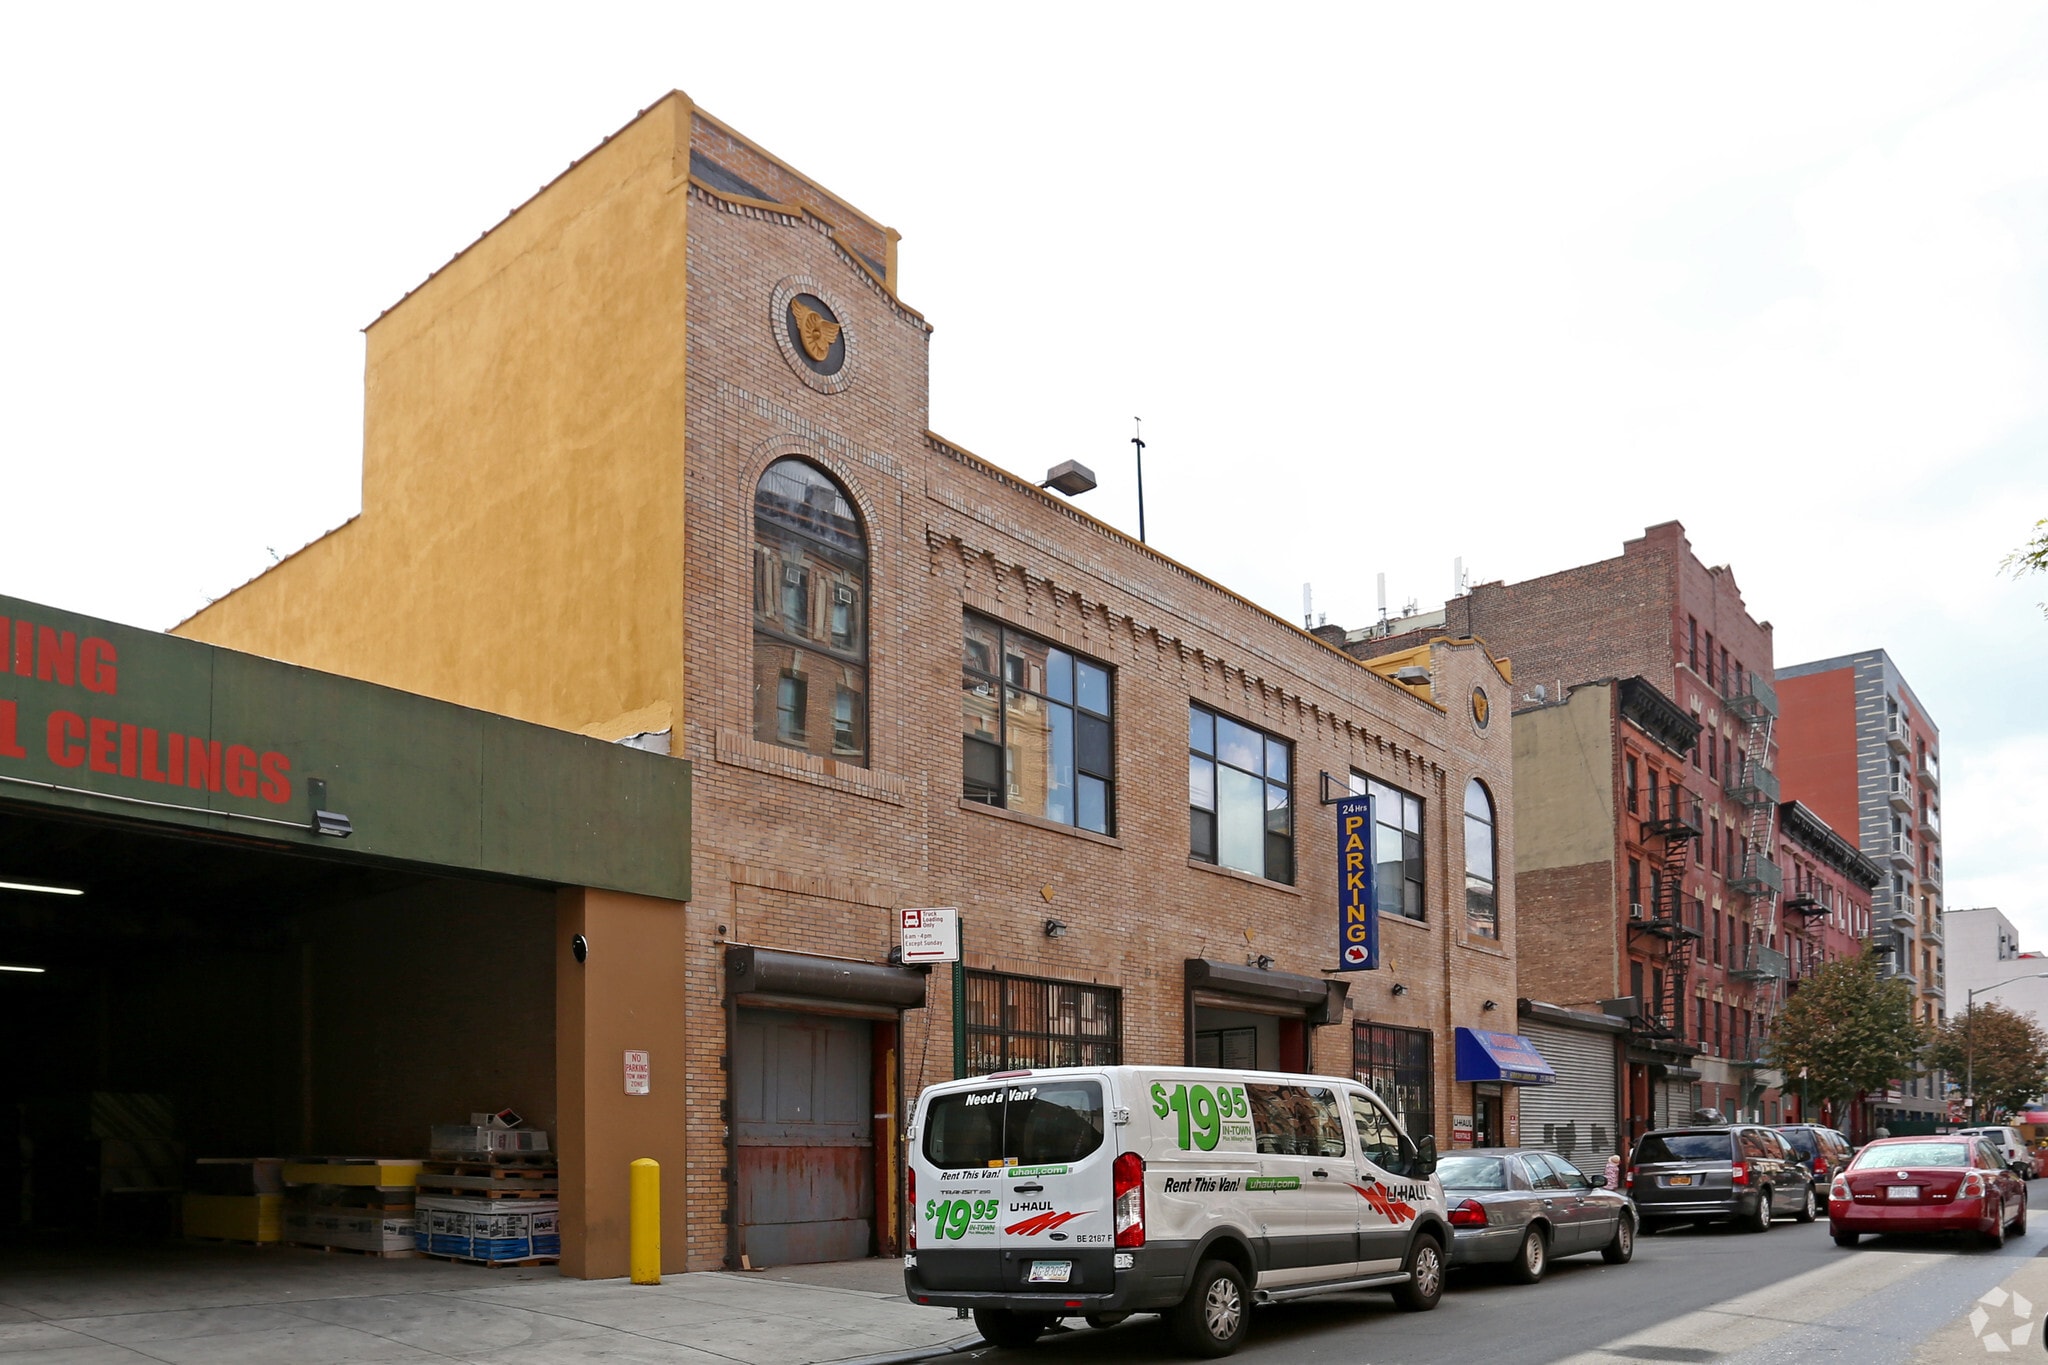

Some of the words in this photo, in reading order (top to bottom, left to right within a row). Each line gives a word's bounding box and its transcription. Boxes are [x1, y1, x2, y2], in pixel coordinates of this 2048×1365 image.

[46, 709, 292, 805] CEILINGS
[1342, 804, 1354, 815] 24
[1355, 805, 1367, 813] Hrs
[1345, 816, 1366, 943] PARKING
[922, 916, 944, 924] Loading
[631, 1053, 642, 1063] NO
[625, 1063, 648, 1073] PARKING
[965, 1091, 996, 1106] Need
[995, 1093, 1004, 1103] a
[1008, 1087, 1038, 1102] Van?
[1222, 1125, 1252, 1135] IN-TOWN
[941, 1172, 961, 1181] Rent
[962, 1171, 979, 1180] This
[981, 1169, 1001, 1179] Van!
[1012, 1166, 1063, 1177] uhaul.com
[1164, 1177, 1193, 1193] Rent
[1193, 1177, 1218, 1192] This
[1218, 1176, 1241, 1192] Van!
[1249, 1178, 1296, 1189] uhaul.com
[1386, 1185, 1432, 1203] U-HAUL
[1009, 1201, 1054, 1212] U-HAUL
[968, 1223, 996, 1232] IN-TOWN
[1076, 1234, 1088, 1243] BE
[1088, 1234, 1106, 1243] 2187
[1107, 1234, 1113, 1242] F
